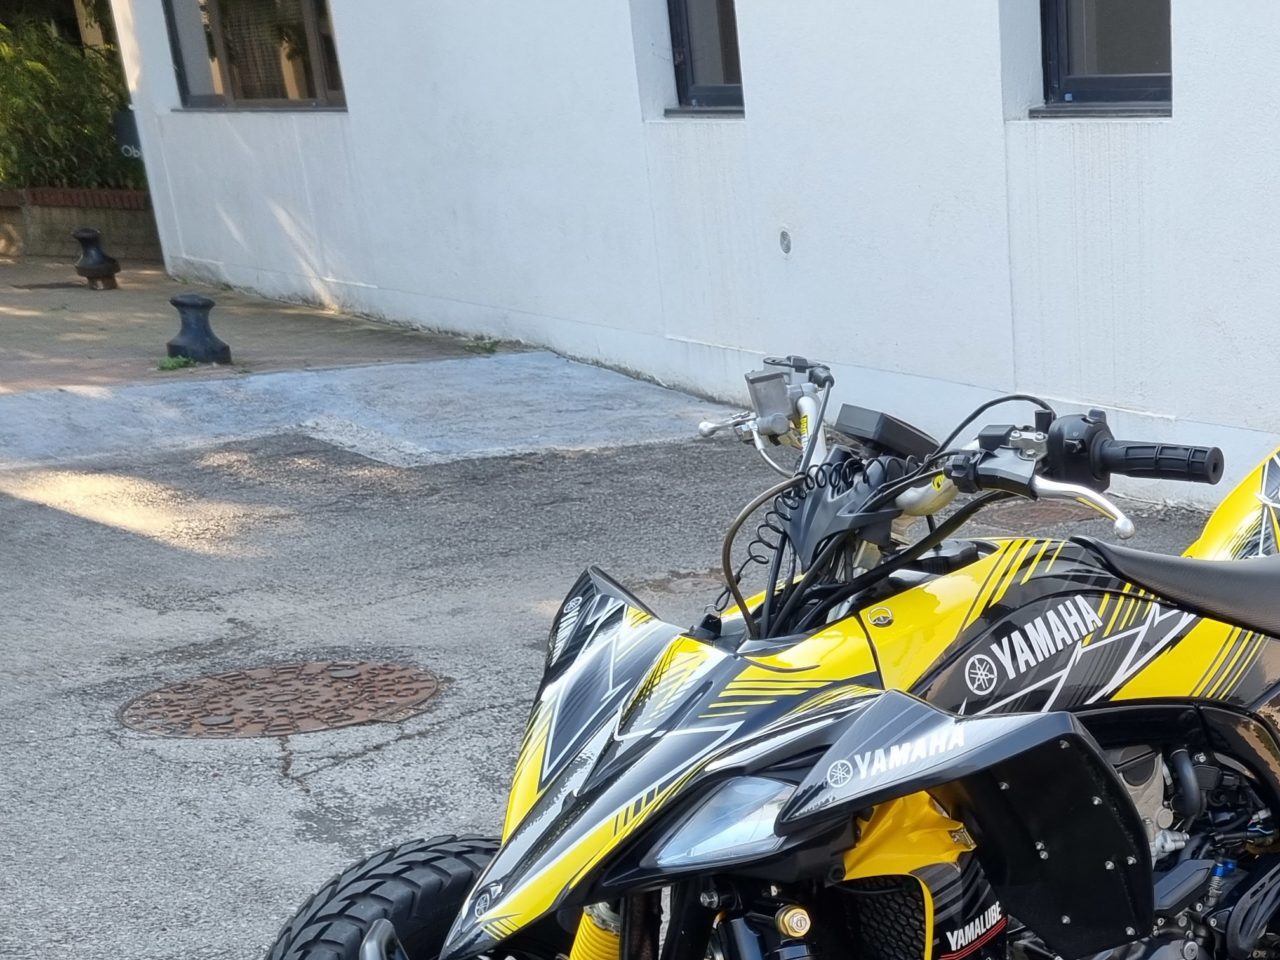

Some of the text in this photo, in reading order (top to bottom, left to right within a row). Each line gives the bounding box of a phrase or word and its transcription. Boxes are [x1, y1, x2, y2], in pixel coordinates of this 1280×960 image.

[990, 594, 1103, 680] YAMAHA
[854, 724, 965, 780] YAMAHA
[946, 900, 1002, 952] YAMALUBE
